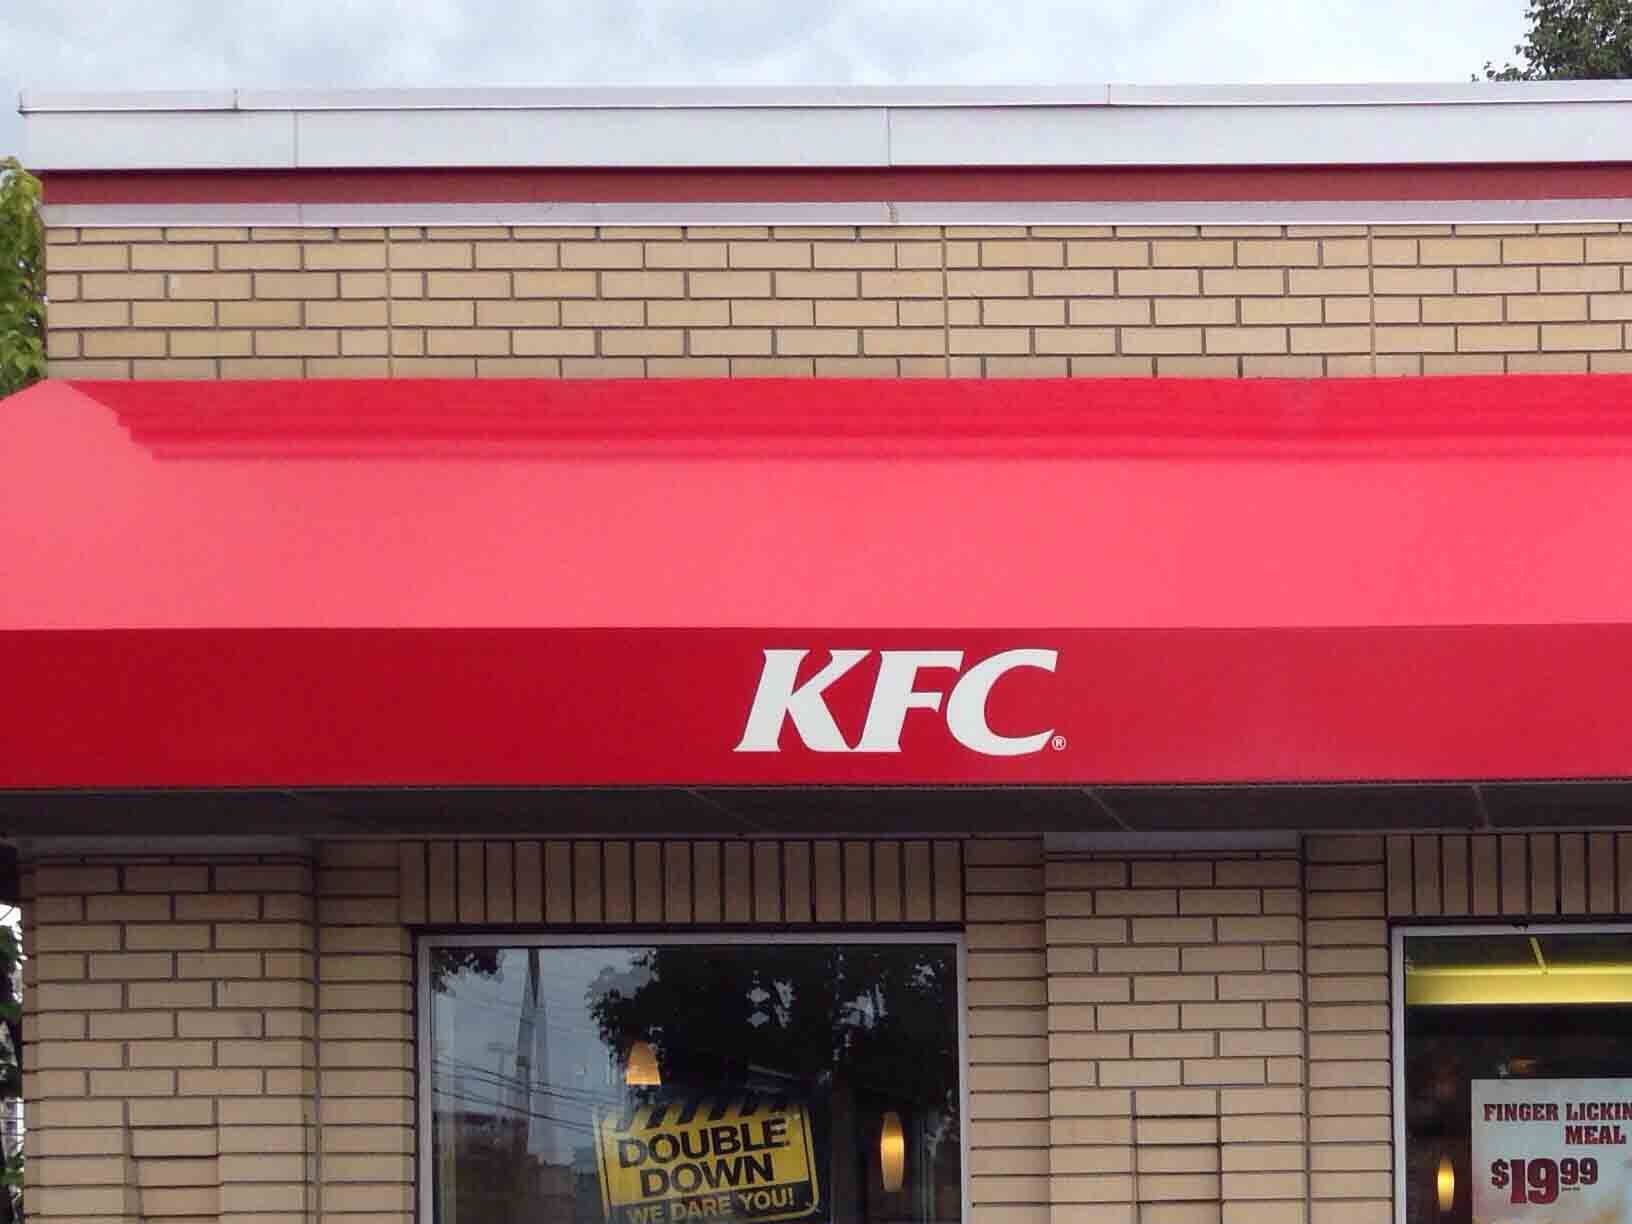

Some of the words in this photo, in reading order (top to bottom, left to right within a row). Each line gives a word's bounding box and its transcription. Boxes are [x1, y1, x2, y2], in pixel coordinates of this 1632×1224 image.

[732, 648, 1059, 756] KFC
[1483, 1102, 1559, 1121] FINGER
[618, 1117, 788, 1168] DOUBLE
[1564, 1124, 1628, 1145] MEAL
[640, 1152, 775, 1198] DOWN
[671, 1195, 732, 1220] DARE
[737, 1187, 795, 1211] YOU!
